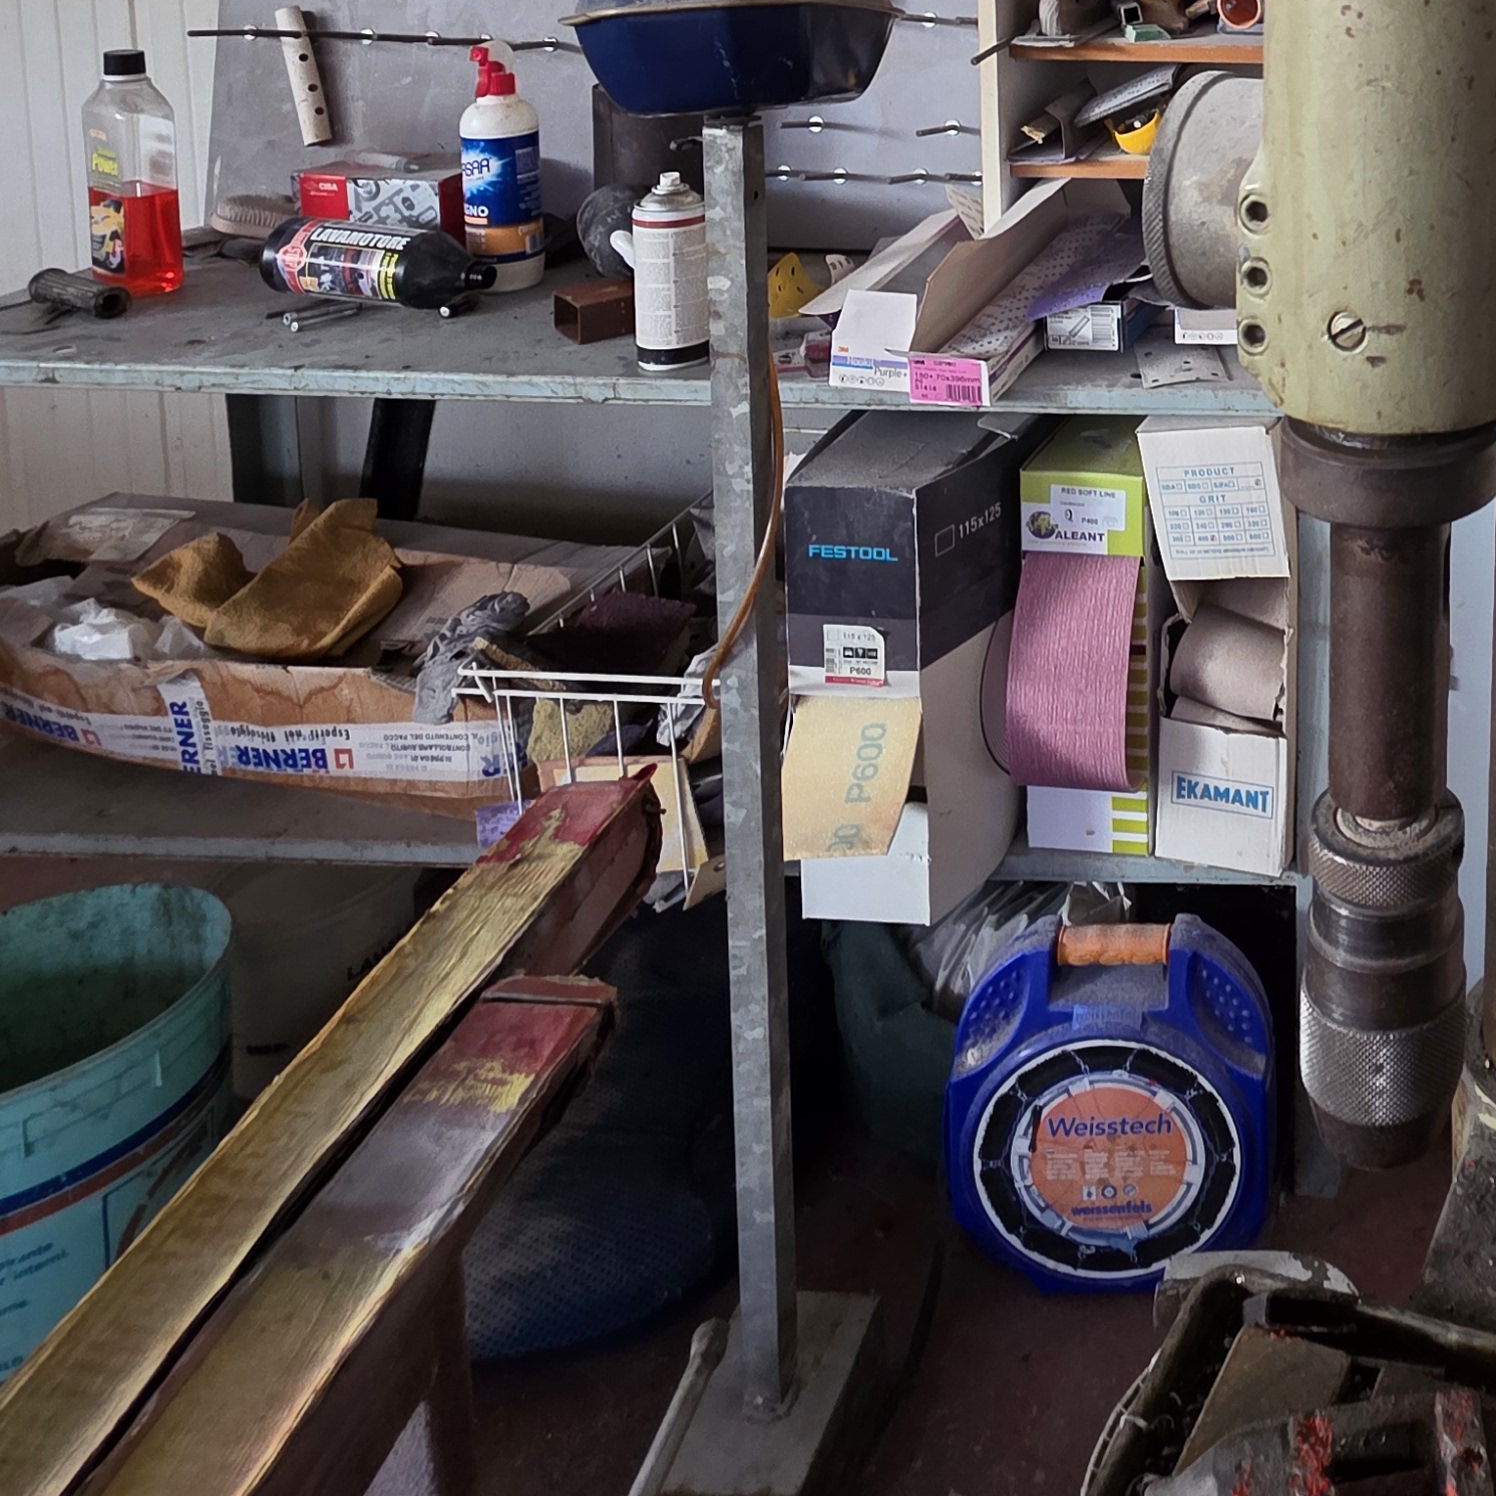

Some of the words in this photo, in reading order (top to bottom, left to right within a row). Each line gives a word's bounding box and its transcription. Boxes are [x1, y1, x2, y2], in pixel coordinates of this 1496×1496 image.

[310, 227, 411, 251] LAVAMOTORE
[1184, 466, 1235, 478] PRODUCT
[957, 502, 1002, 540] 115x125
[808, 543, 899, 562] FESTOOL
[235, 744, 328, 770] BERNER
[844, 722, 888, 804] P600
[1176, 775, 1270, 814] EKAMANT
[1048, 1112, 1172, 1138] Weisstech
